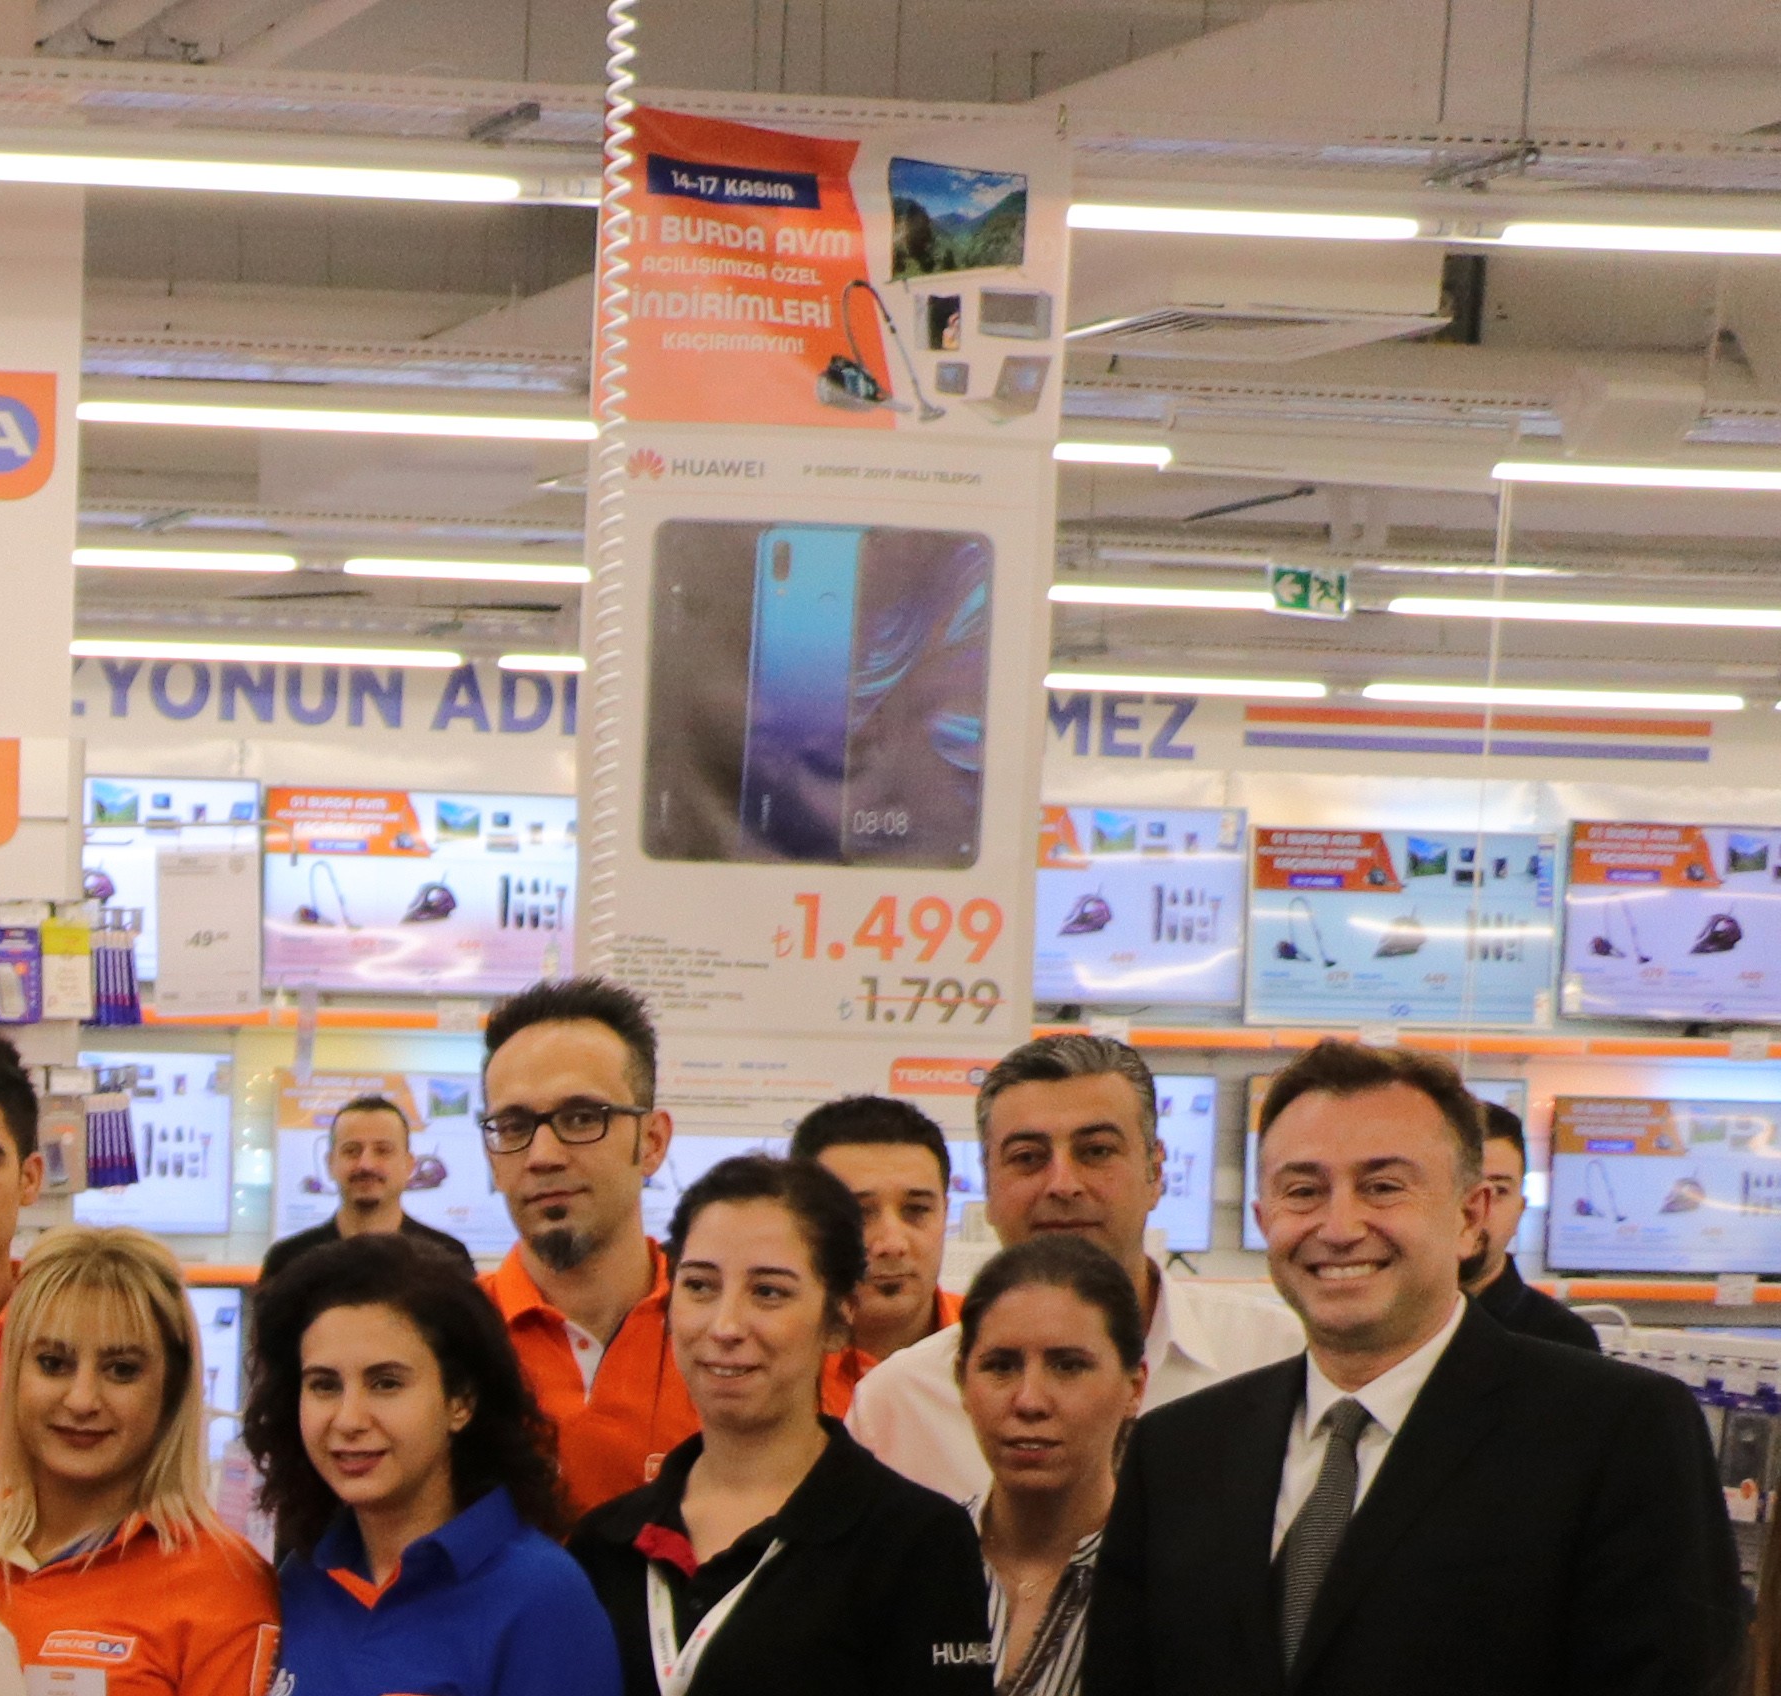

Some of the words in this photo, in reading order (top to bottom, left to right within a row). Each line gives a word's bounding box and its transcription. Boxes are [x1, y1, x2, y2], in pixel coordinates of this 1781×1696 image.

[671, 169, 718, 194] 14-17
[724, 176, 796, 202] KASIM
[661, 216, 765, 249] BURDA
[775, 225, 852, 259] AVM
[771, 260, 822, 286] ÖZEL
[631, 283, 832, 330] İNDİRİMLERİ
[662, 329, 805, 355] KAÇIRMAYIN!
[671, 458, 765, 479] HUAWEI
[72, 657, 404, 731] YONUN
[1045, 693, 1197, 760] MEZ
[893, 1068, 985, 1087] TEKNOS
[47, 1638, 127, 1655] TEKNOSA
